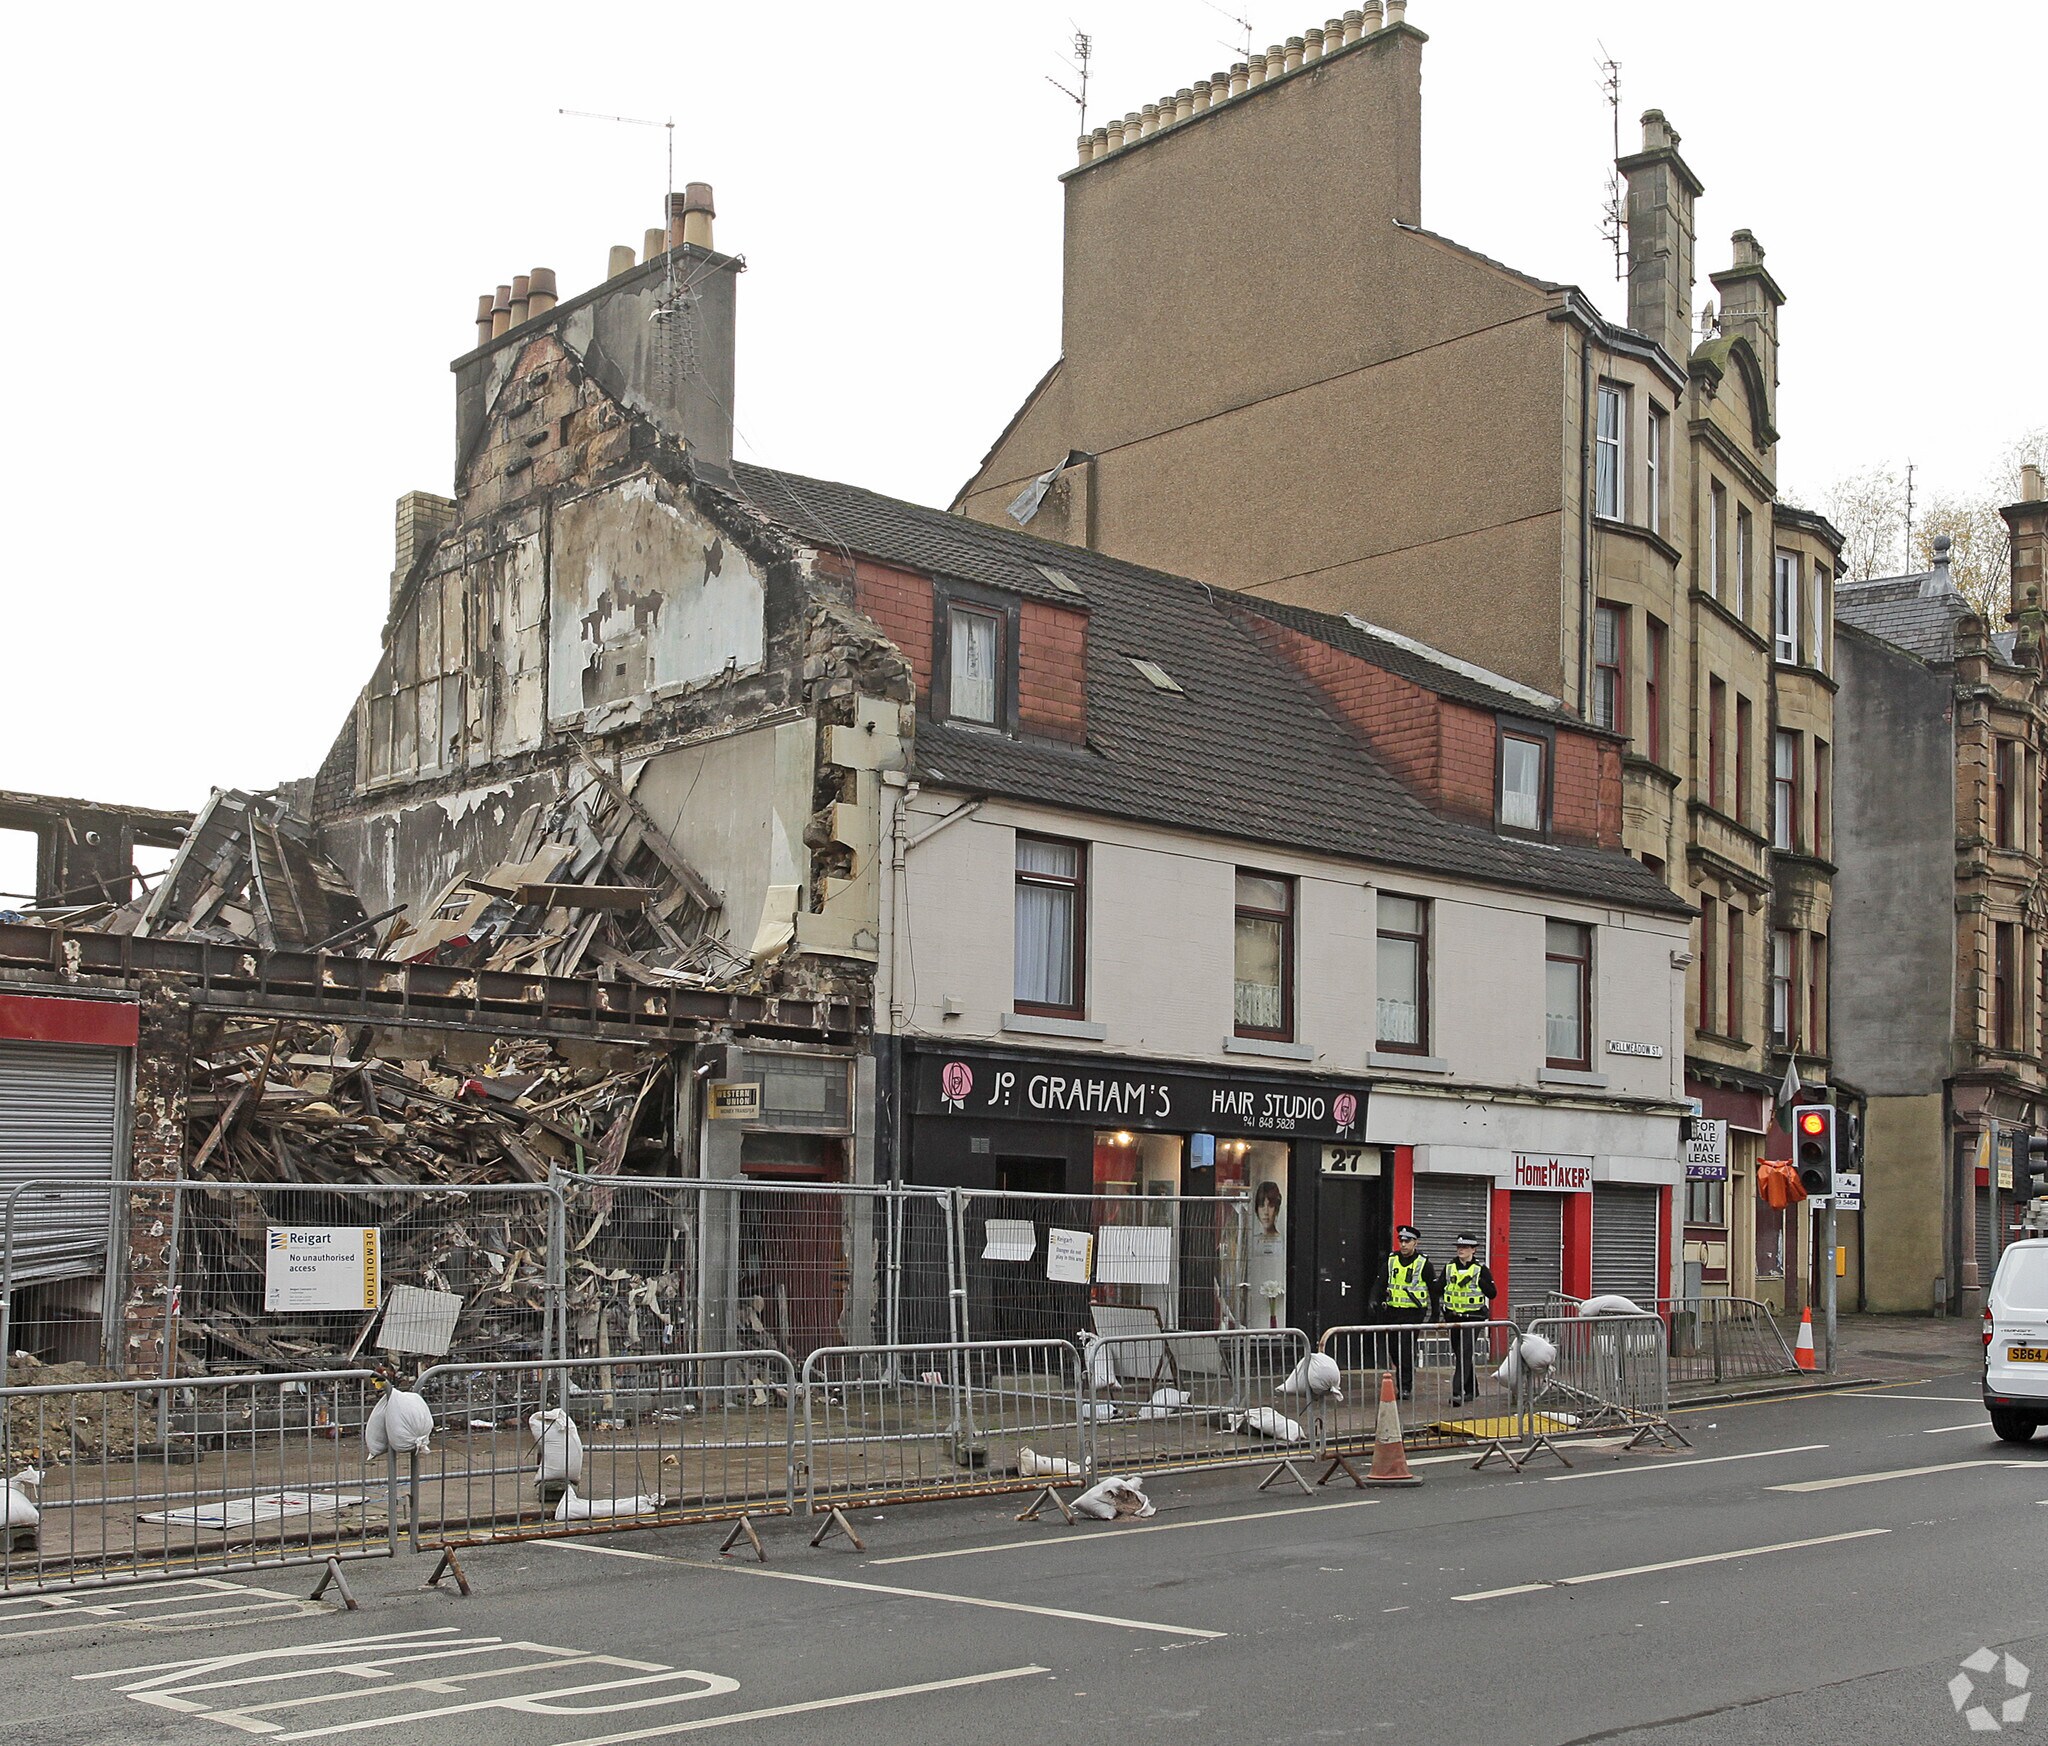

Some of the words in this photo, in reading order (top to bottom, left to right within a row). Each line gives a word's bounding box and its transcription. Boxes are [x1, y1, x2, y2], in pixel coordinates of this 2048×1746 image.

[1611, 1041, 1651, 1055] WELLMEADOW
[726, 1098, 750, 1106] UNION
[1028, 1075, 1171, 1117] GRAHAM'S
[1211, 1089, 1254, 1115] HAIR
[1262, 1093, 1326, 1121] STUDIO
[1259, 1116, 1274, 1128] 848
[1276, 1117, 1295, 1130] 5828
[1693, 1143, 1715, 1152] MAY
[1331, 1148, 1362, 1172] 27
[1688, 1153, 1720, 1163] LEASE
[1697, 1166, 1723, 1176] 3621
[290, 1233, 331, 1245] Reigart
[366, 1233, 374, 1304] DEMOLITION
[2012, 1348, 2042, 1360] SB64
